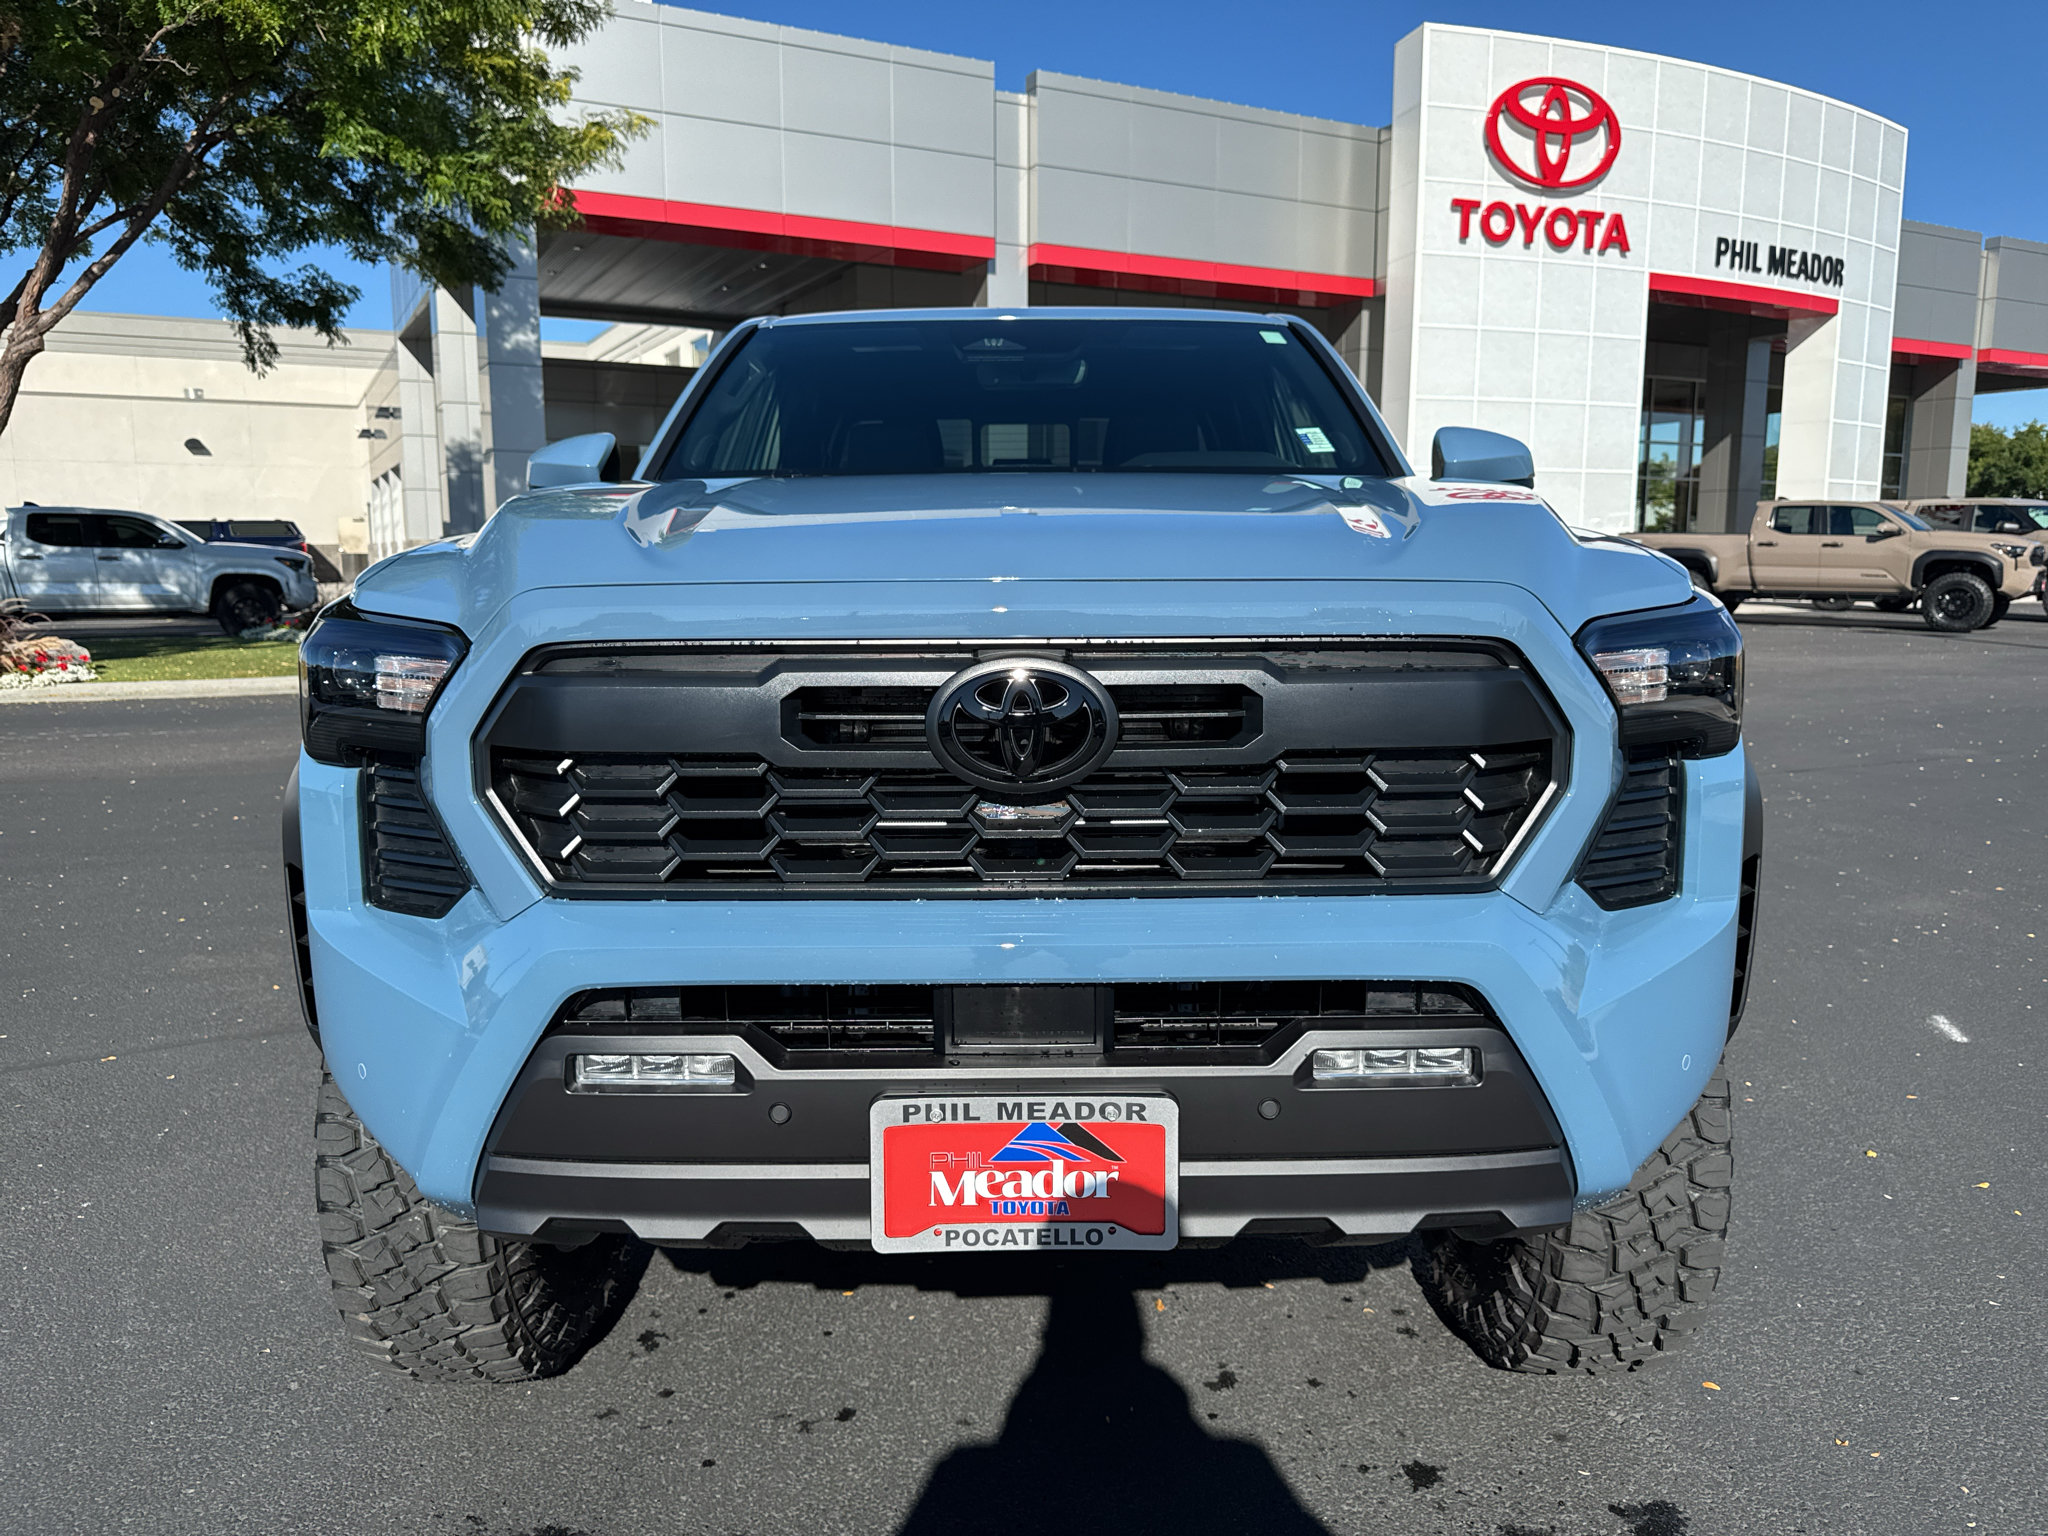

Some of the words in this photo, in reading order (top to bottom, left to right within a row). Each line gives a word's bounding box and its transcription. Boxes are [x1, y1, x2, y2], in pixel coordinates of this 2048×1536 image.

[1451, 198, 1631, 255] TOYOTA
[1714, 237, 1762, 273] PHIL
[1767, 245, 1845, 288] MEADOR
[902, 1103, 981, 1123] PHIL
[997, 1102, 1147, 1121] MEADOR
[929, 1152, 995, 1169] PHIL
[928, 1159, 1120, 1206] Meador
[988, 1200, 1071, 1216] TOYOTA
[945, 1227, 1105, 1247] POCATELLO
